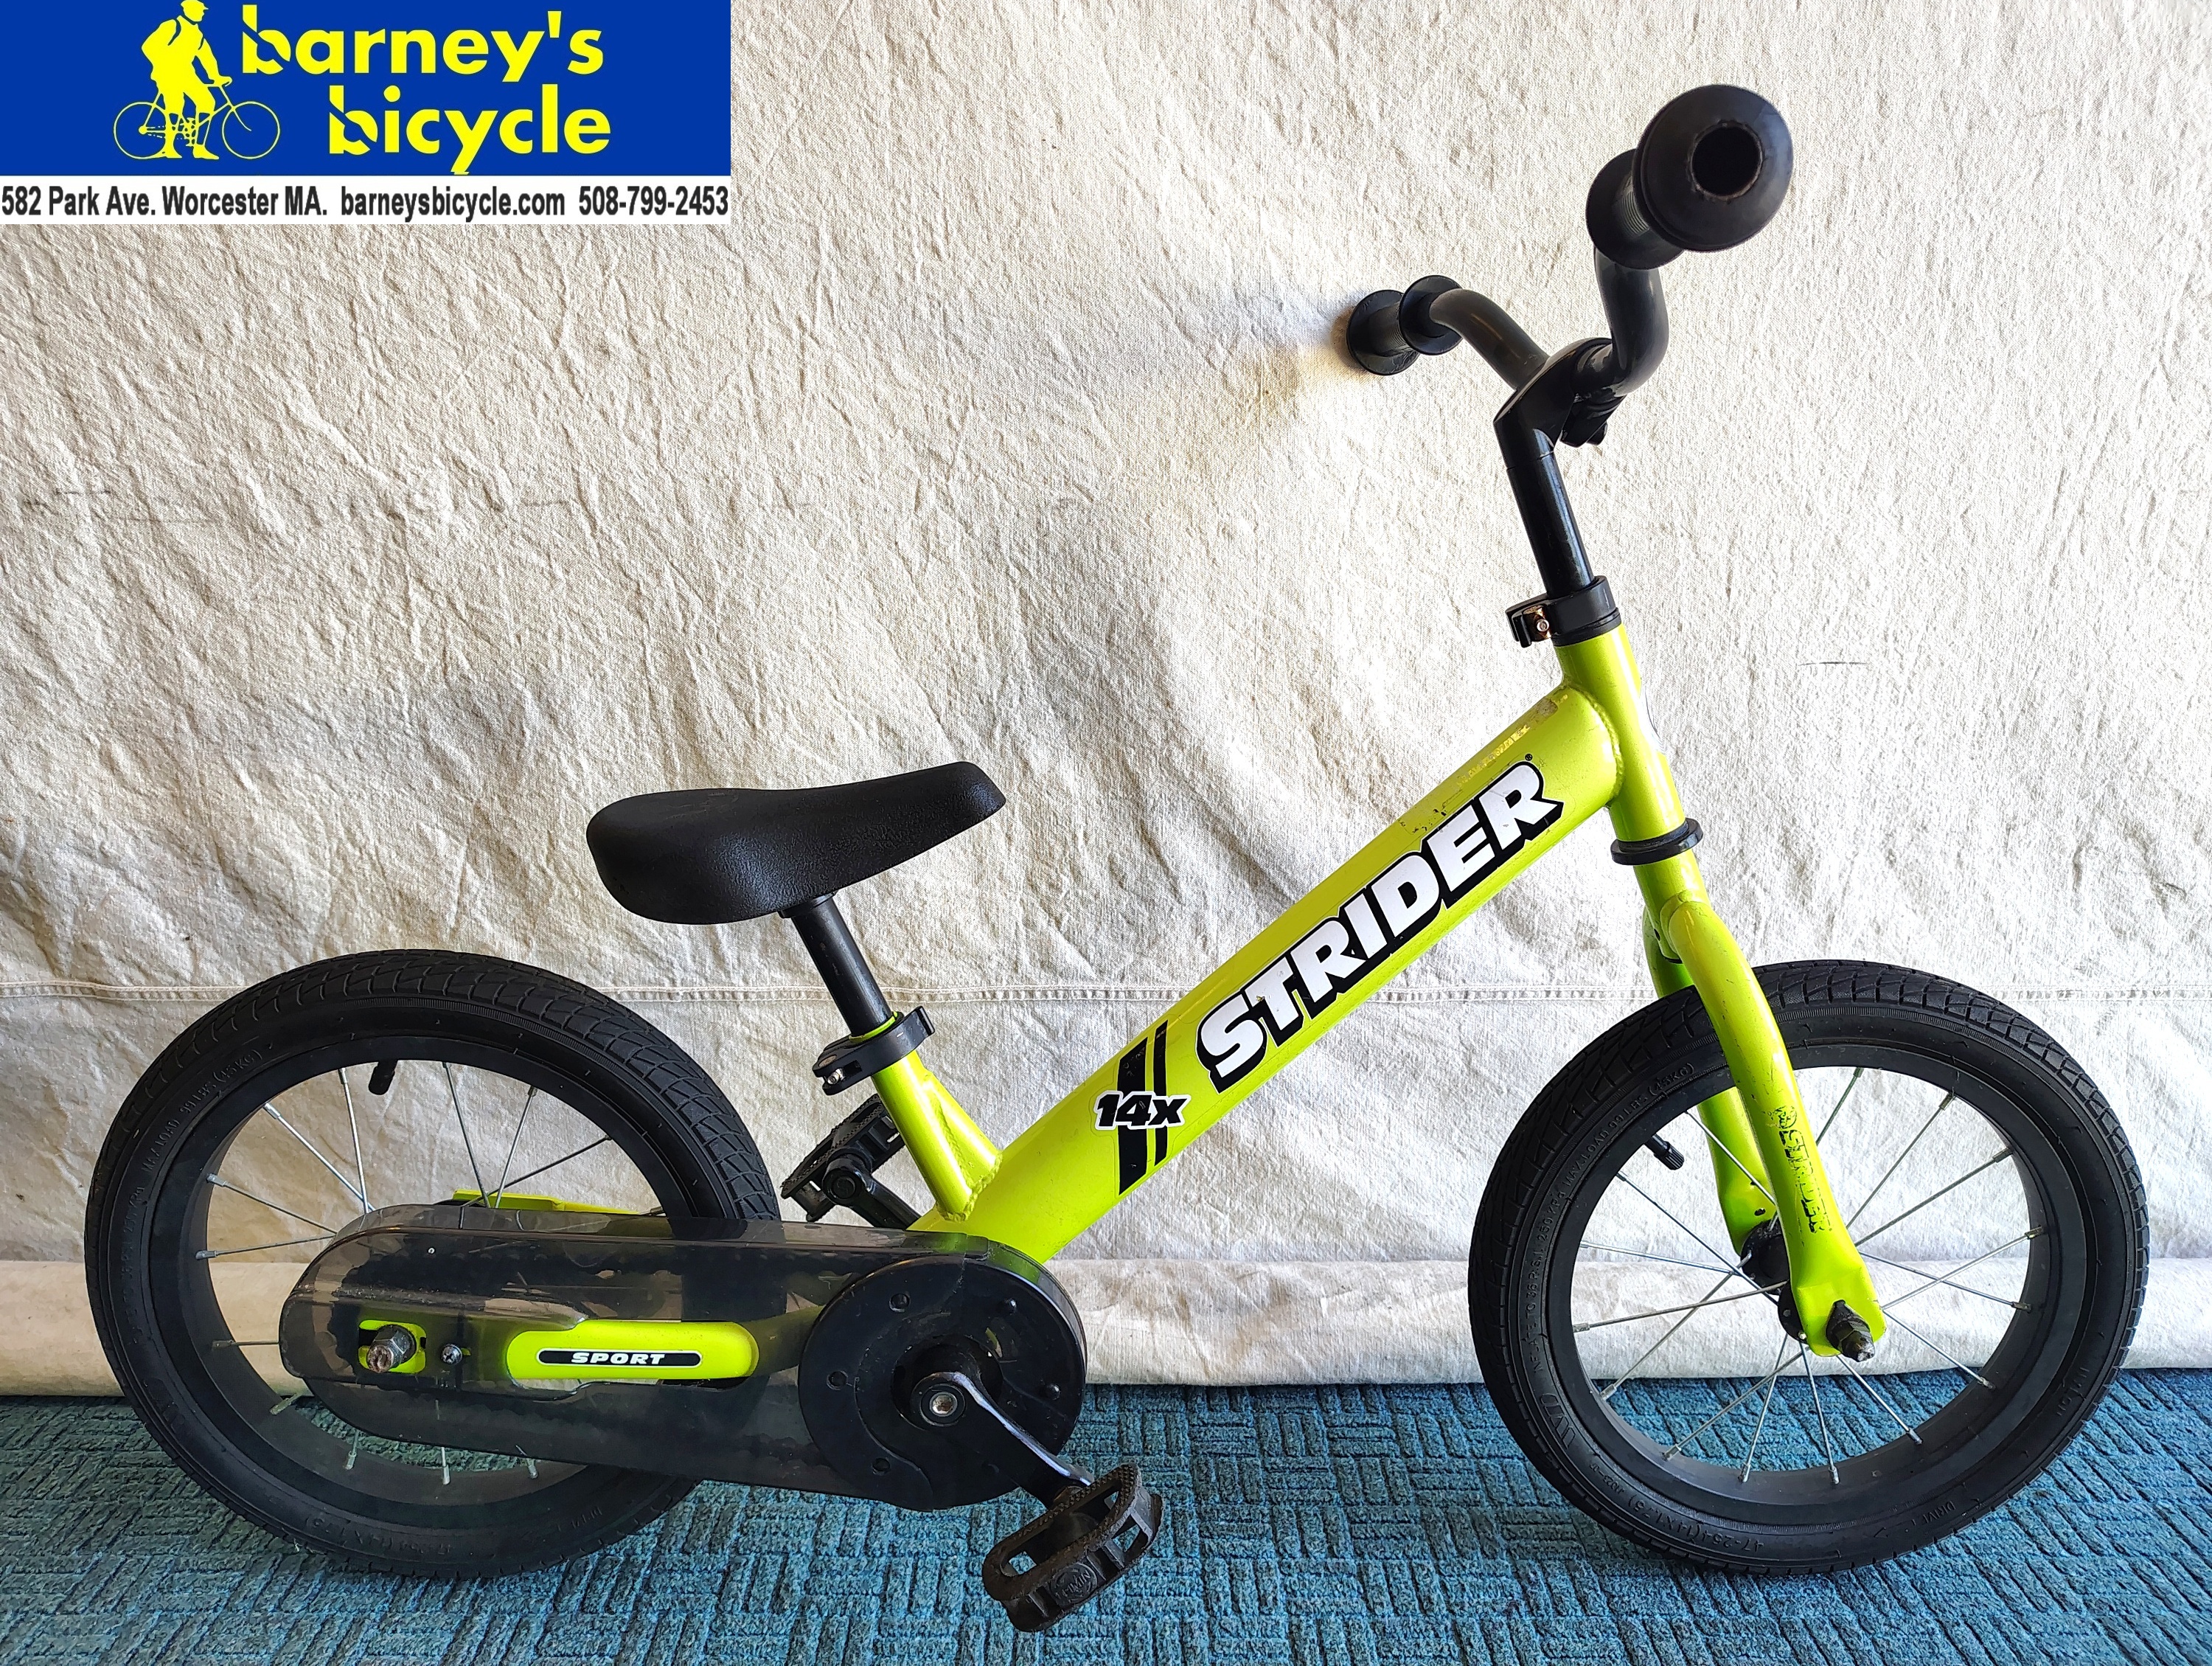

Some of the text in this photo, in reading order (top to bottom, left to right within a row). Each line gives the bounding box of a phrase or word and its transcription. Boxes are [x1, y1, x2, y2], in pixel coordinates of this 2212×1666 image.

[1197, 761, 1562, 1088] STRIDER
[1778, 1129, 1832, 1234] STRDER
[571, 1352, 665, 1364] SPORT
